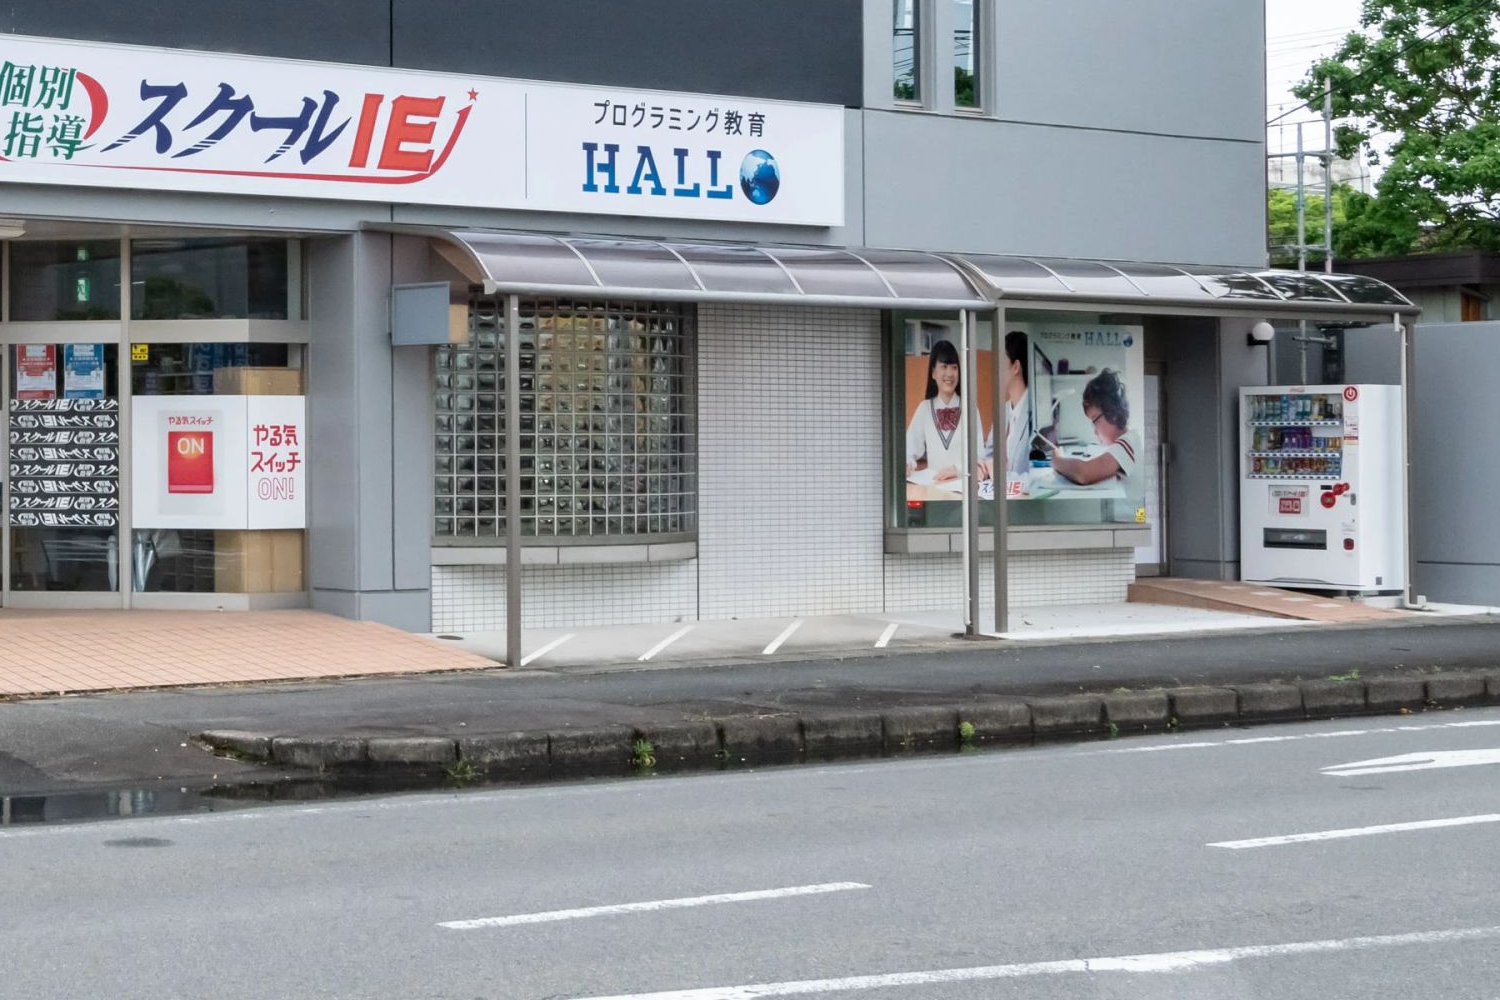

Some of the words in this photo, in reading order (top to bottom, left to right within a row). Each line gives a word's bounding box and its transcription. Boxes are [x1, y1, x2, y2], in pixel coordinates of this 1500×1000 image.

[594, 99, 766, 138] プログラミング教育
[2, 112, 90, 161] 指導
[168, 416, 214, 426] やる気スイッチ
[177, 437, 204, 455] ON
[253, 424, 298, 446] やる気
[251, 451, 301, 473] スイッチ
[258, 477, 294, 501] ON!
